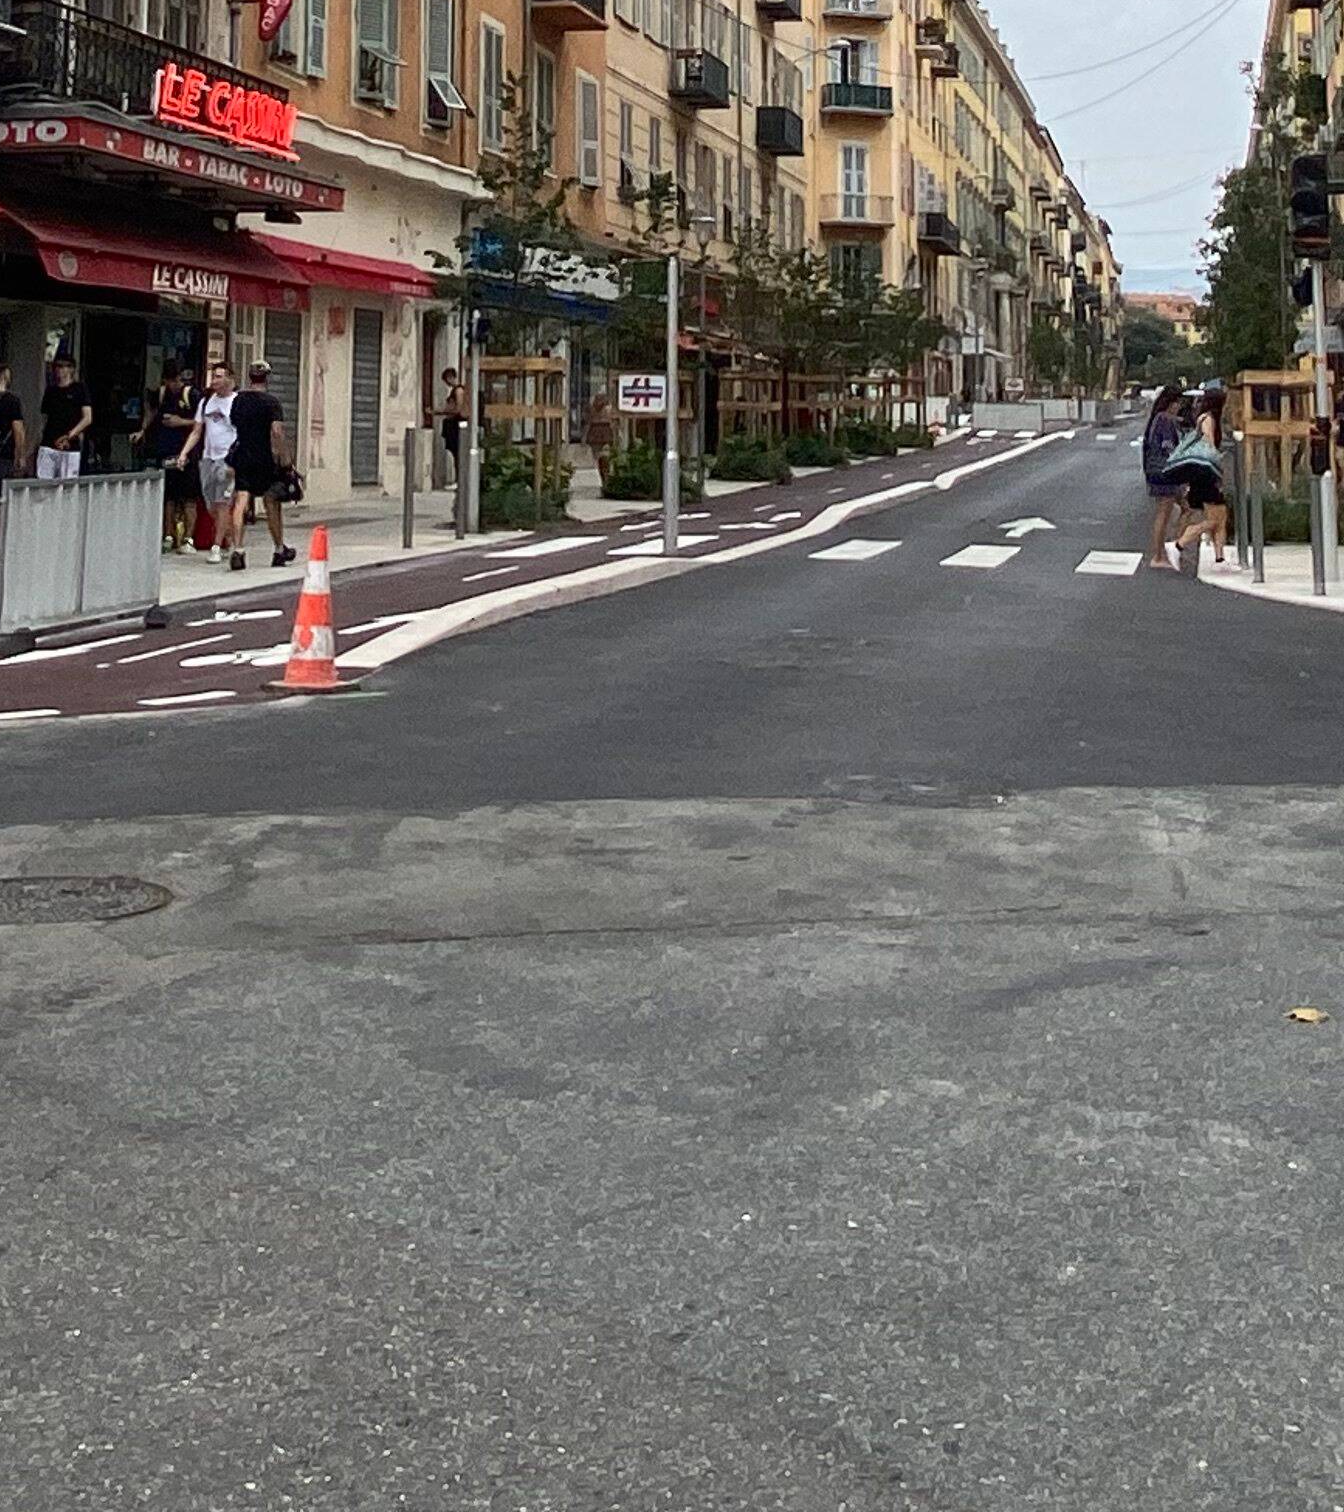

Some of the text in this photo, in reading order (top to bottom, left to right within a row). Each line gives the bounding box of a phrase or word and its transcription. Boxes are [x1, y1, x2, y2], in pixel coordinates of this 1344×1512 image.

[160, 63, 207, 118] LE
[142, 138, 304, 199] BAR TABAC LOTO
[153, 264, 229, 298] LE CASSINI
